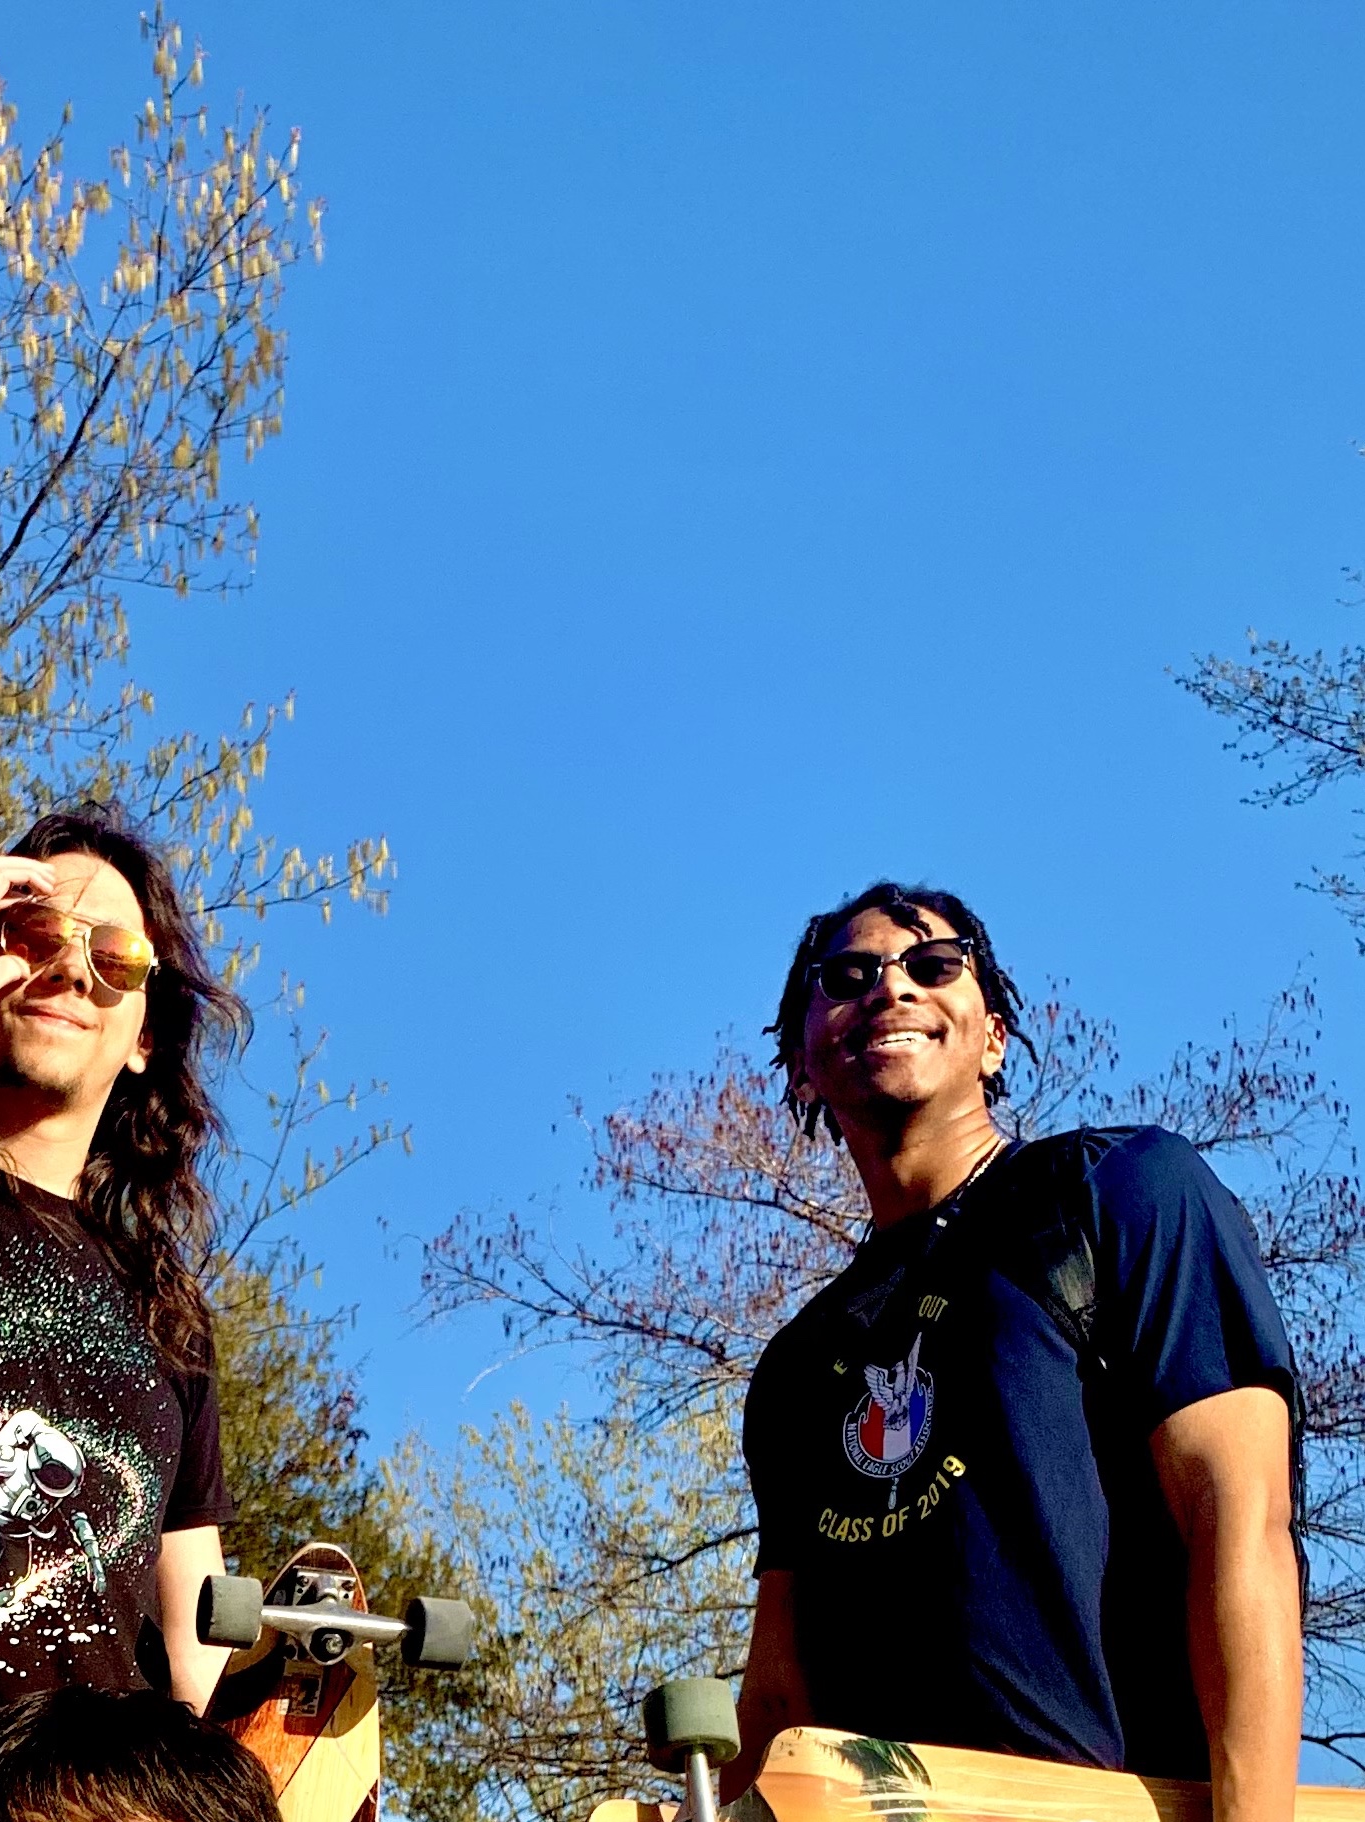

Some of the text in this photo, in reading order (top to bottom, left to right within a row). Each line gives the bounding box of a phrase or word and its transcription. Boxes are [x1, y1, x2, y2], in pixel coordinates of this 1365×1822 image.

[846, 1422, 866, 1466] NATIONAL
[862, 1460, 889, 1475] EAGLE
[889, 1451, 915, 1475] SCOUT
[818, 1455, 967, 1542] CLASS OF 2019
